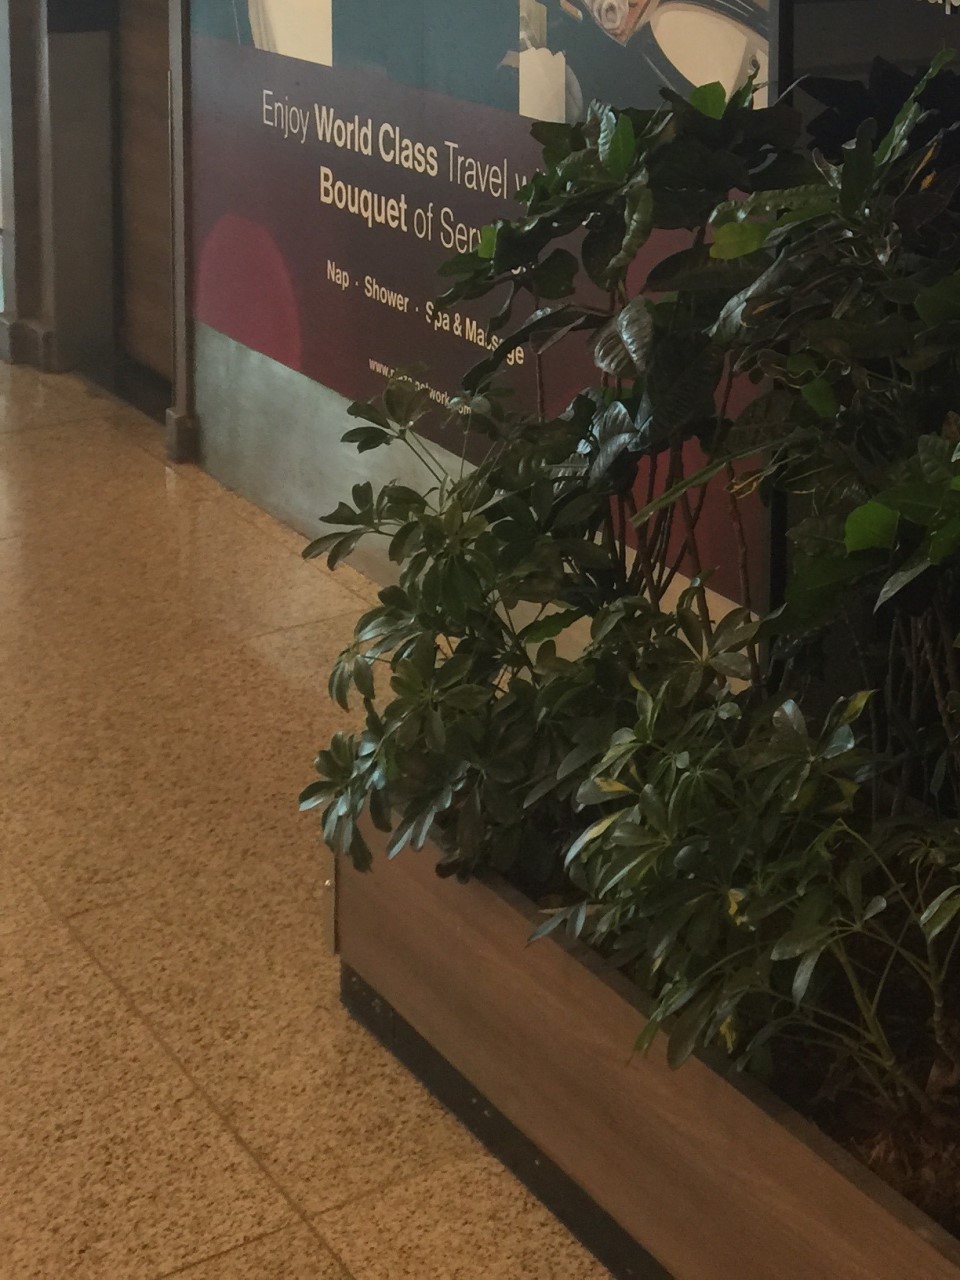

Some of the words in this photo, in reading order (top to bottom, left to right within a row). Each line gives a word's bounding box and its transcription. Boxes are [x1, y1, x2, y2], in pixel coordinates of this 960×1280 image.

[262, 89, 310, 144] Enjoy
[313, 103, 373, 157] World
[378, 122, 439, 177] Class
[444, 140, 508, 200] Travel
[319, 166, 408, 233] Bouquet
[413, 202, 433, 241] of
[327, 259, 350, 291] Nap
[364, 275, 410, 312] Shower
[425, 301, 450, 331] Spa
[453, 312, 463, 337] &
